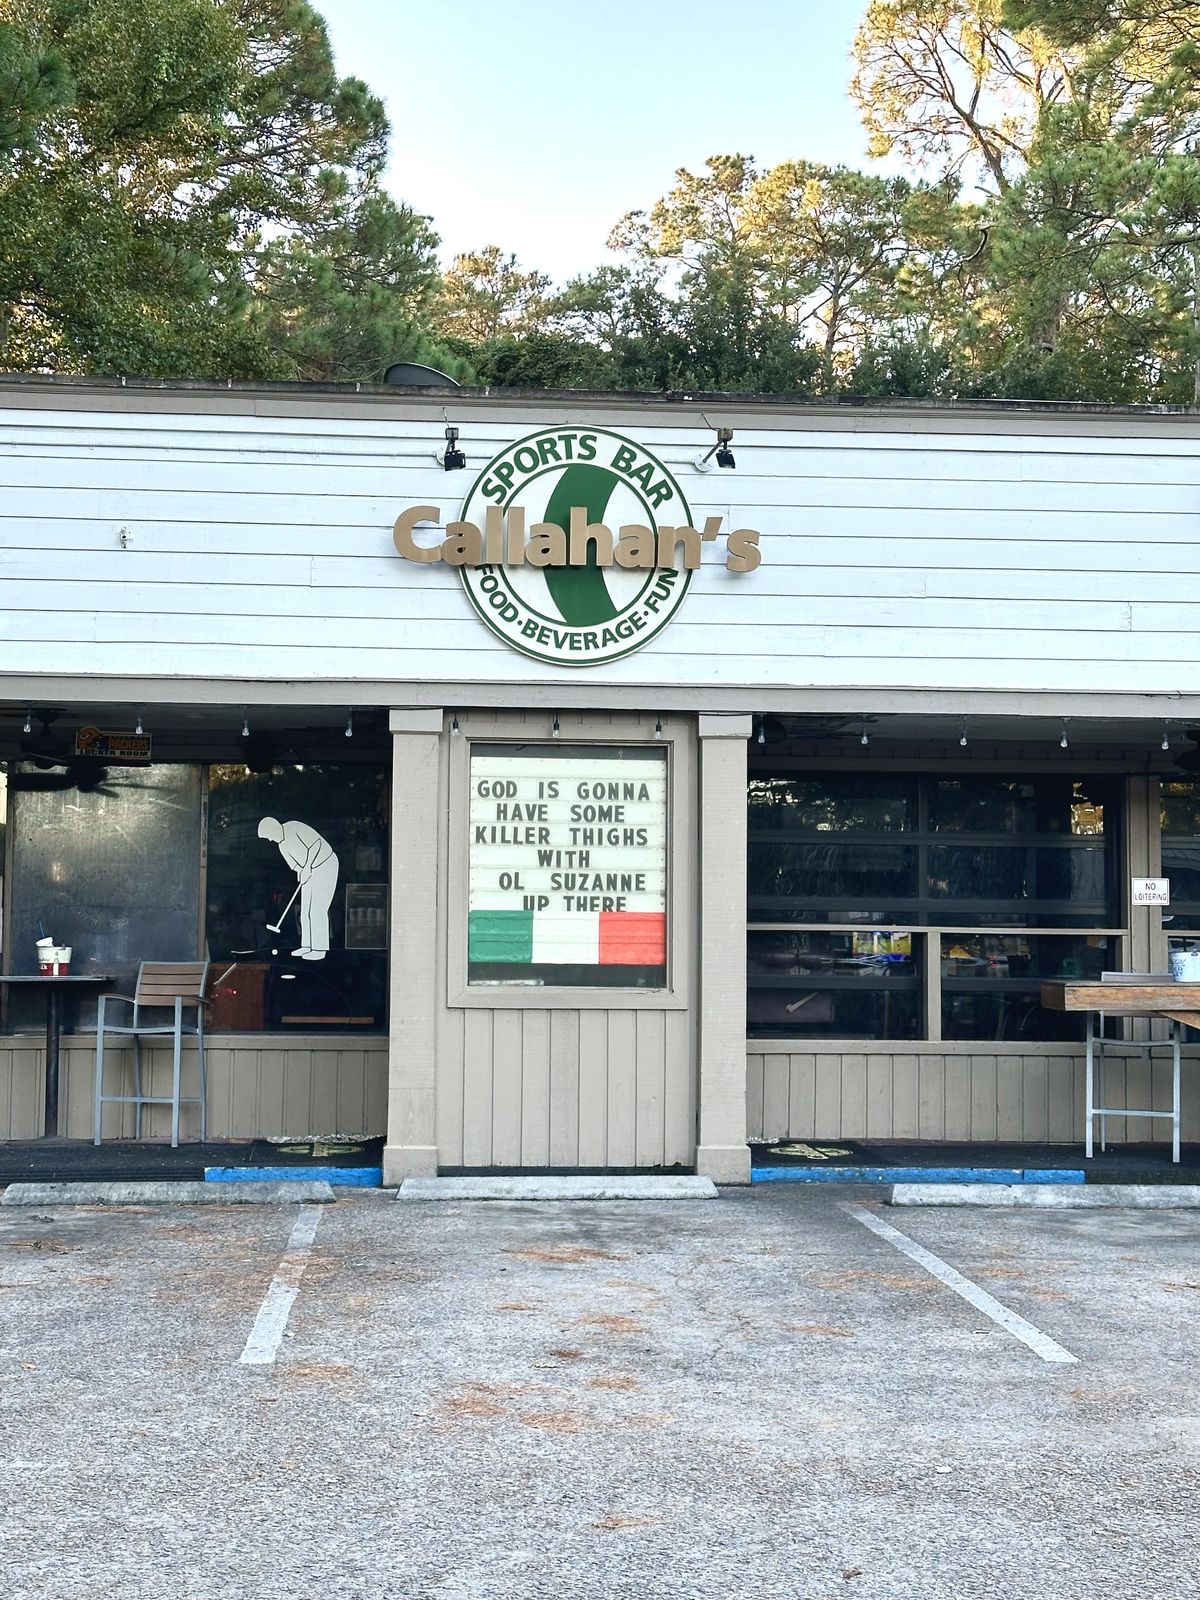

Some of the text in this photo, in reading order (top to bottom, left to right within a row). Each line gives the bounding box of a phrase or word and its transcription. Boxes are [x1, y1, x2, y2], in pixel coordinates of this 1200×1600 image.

[481, 433, 675, 509] SPORTS BAR
[393, 505, 761, 573] Callahan's
[474, 564, 679, 651] FOOD BEVERAGE FUN
[110, 739, 148, 750] PACKERS
[477, 780, 650, 801] GOD IS GONNA
[496, 803, 625, 823] HAVE SOME
[475, 825, 648, 847] KILLER THIGHS
[537, 849, 590, 868] WITH
[498, 872, 646, 892] OL SUZANNE
[1145, 882, 1157, 891] NO
[523, 895, 627, 912] UP THERE
[1134, 892, 1167, 901] LOITERING
